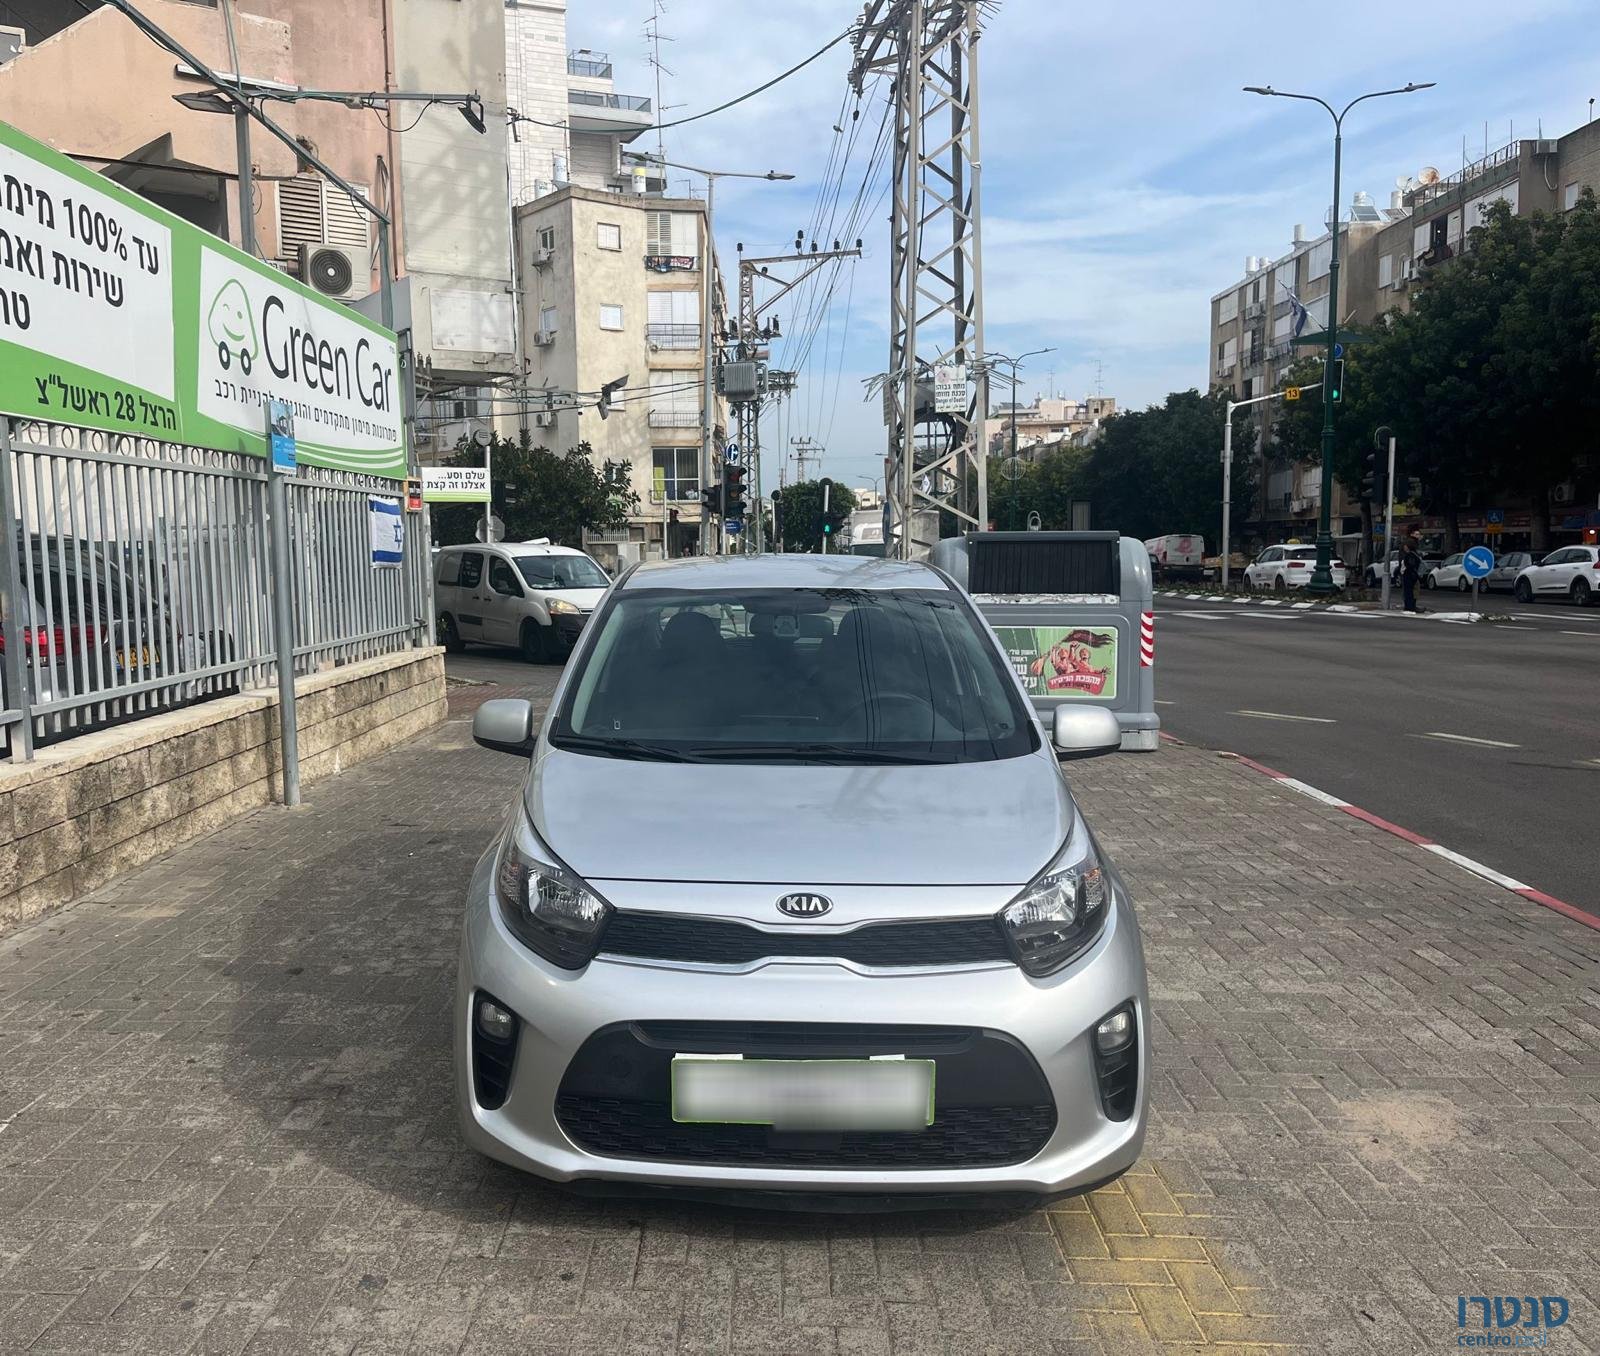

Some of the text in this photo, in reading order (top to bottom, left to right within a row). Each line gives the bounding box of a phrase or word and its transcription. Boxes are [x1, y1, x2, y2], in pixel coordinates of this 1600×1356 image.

[0, 174, 159, 275] עד 100% מימ
[52, 250, 124, 307] שירות
[263, 295, 392, 413] Green Car
[214, 378, 237, 401] רכב
[35, 373, 177, 430] הרצל 28 ראשל"צ
[314, 407, 350, 431] מתקדמים
[352, 418, 371, 436] מימון
[372, 424, 397, 442] פתרונות
[426, 480, 486, 491] אצלנו זה קצת
[438, 470, 486, 480] שלם וסע...
[786, 896, 823, 911] KIA
